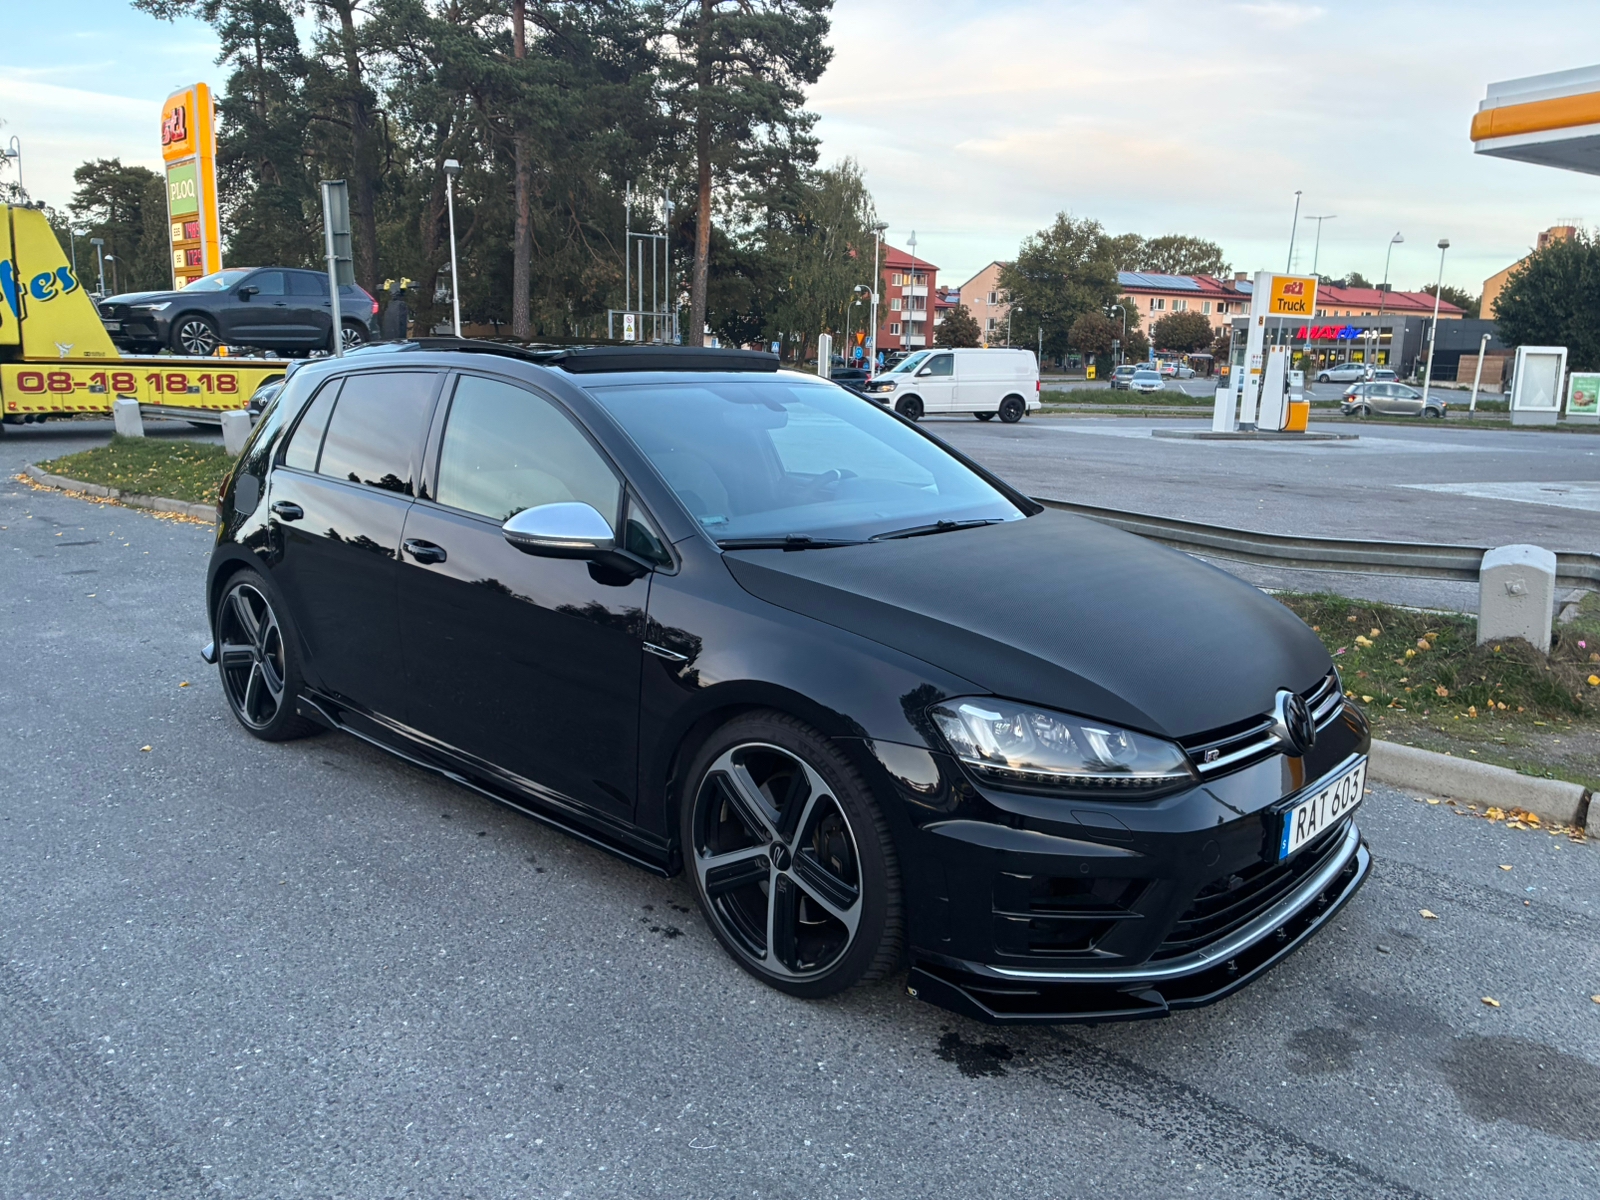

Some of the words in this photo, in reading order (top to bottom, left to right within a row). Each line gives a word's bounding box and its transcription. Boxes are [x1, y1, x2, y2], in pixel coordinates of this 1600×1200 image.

[170, 179, 196, 201] PLOQ
[1277, 298, 1306, 312] Truck
[17, 371, 136, 393] 08-18
[146, 373, 188, 393] 18
[198, 373, 239, 393] 18
[1295, 789, 1329, 844] RAT
[1331, 768, 1360, 816] 603
[1282, 839, 1287, 849] S
